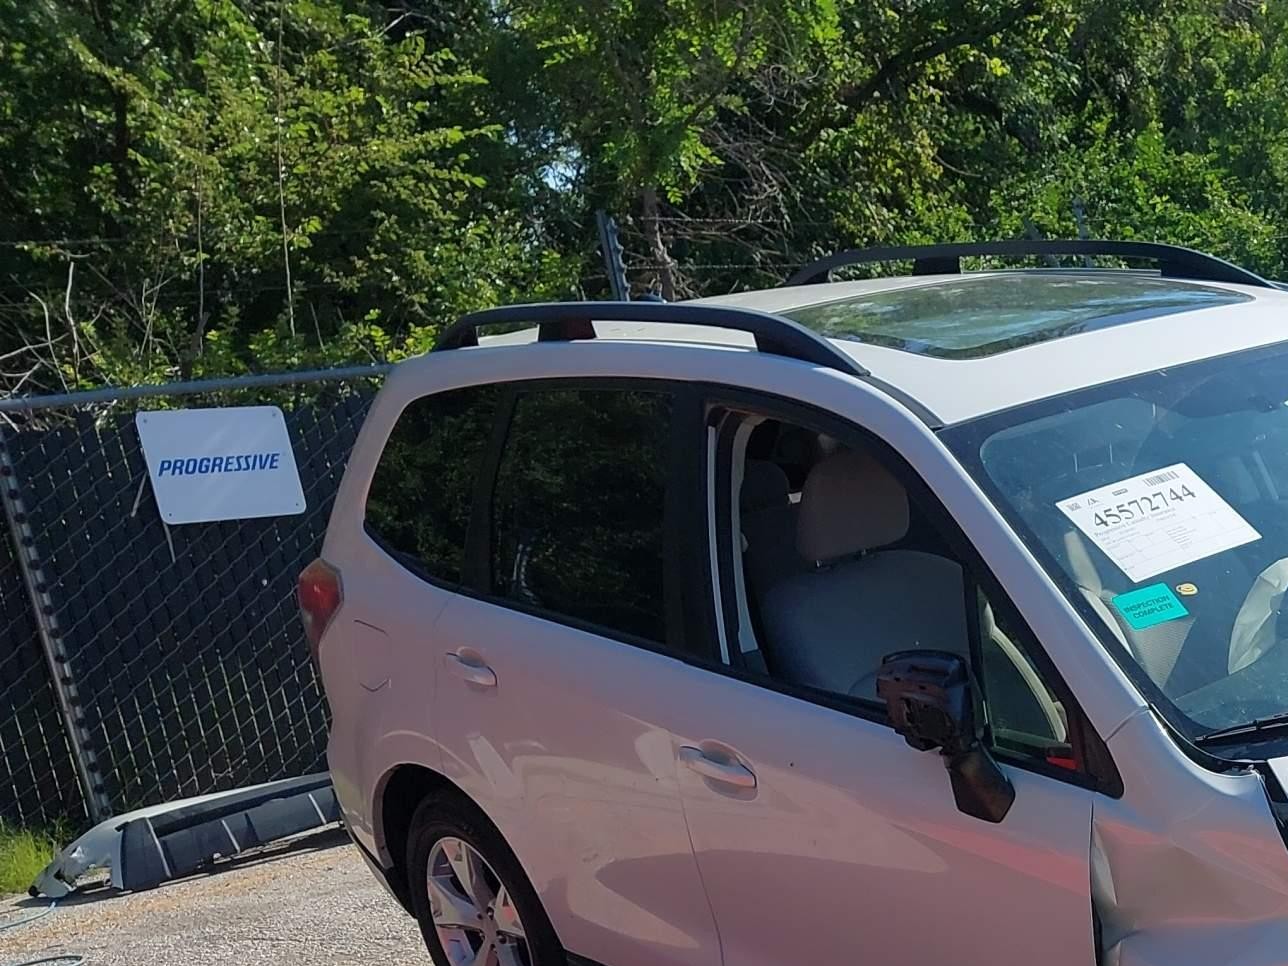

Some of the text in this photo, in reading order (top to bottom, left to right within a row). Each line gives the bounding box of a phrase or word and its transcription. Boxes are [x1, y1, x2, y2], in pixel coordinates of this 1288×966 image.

[158, 453, 280, 477] PROGRESSIVE
[1094, 483, 1196, 528] 45572744
[1123, 594, 1171, 613] INSPECTION
[1133, 602, 1174, 619] COMPLETE
